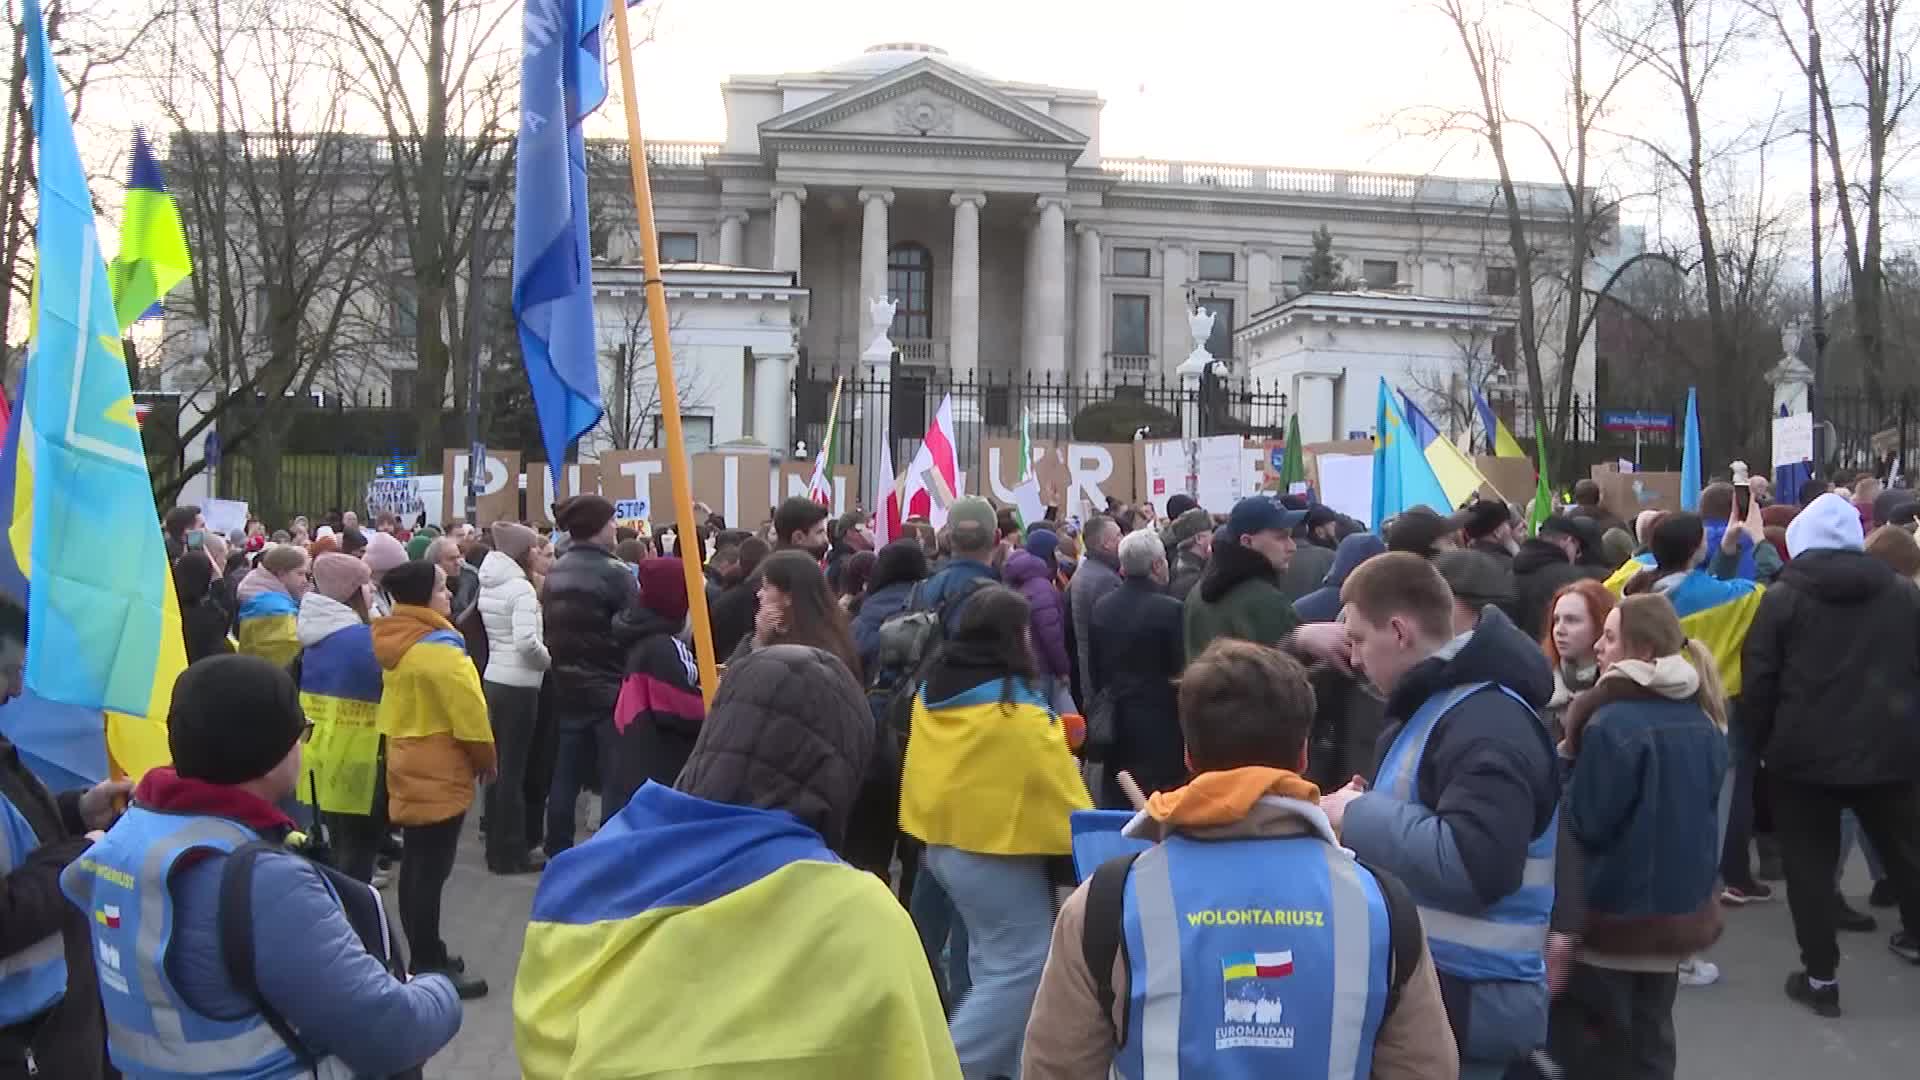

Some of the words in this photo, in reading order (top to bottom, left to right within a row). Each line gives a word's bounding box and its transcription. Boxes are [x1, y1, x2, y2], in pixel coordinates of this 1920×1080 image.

[617, 502, 645, 518] STOP
[1187, 909, 1324, 927] WOLONTARIUSZ
[1216, 1026, 1294, 1041] EUROMAIDAN
